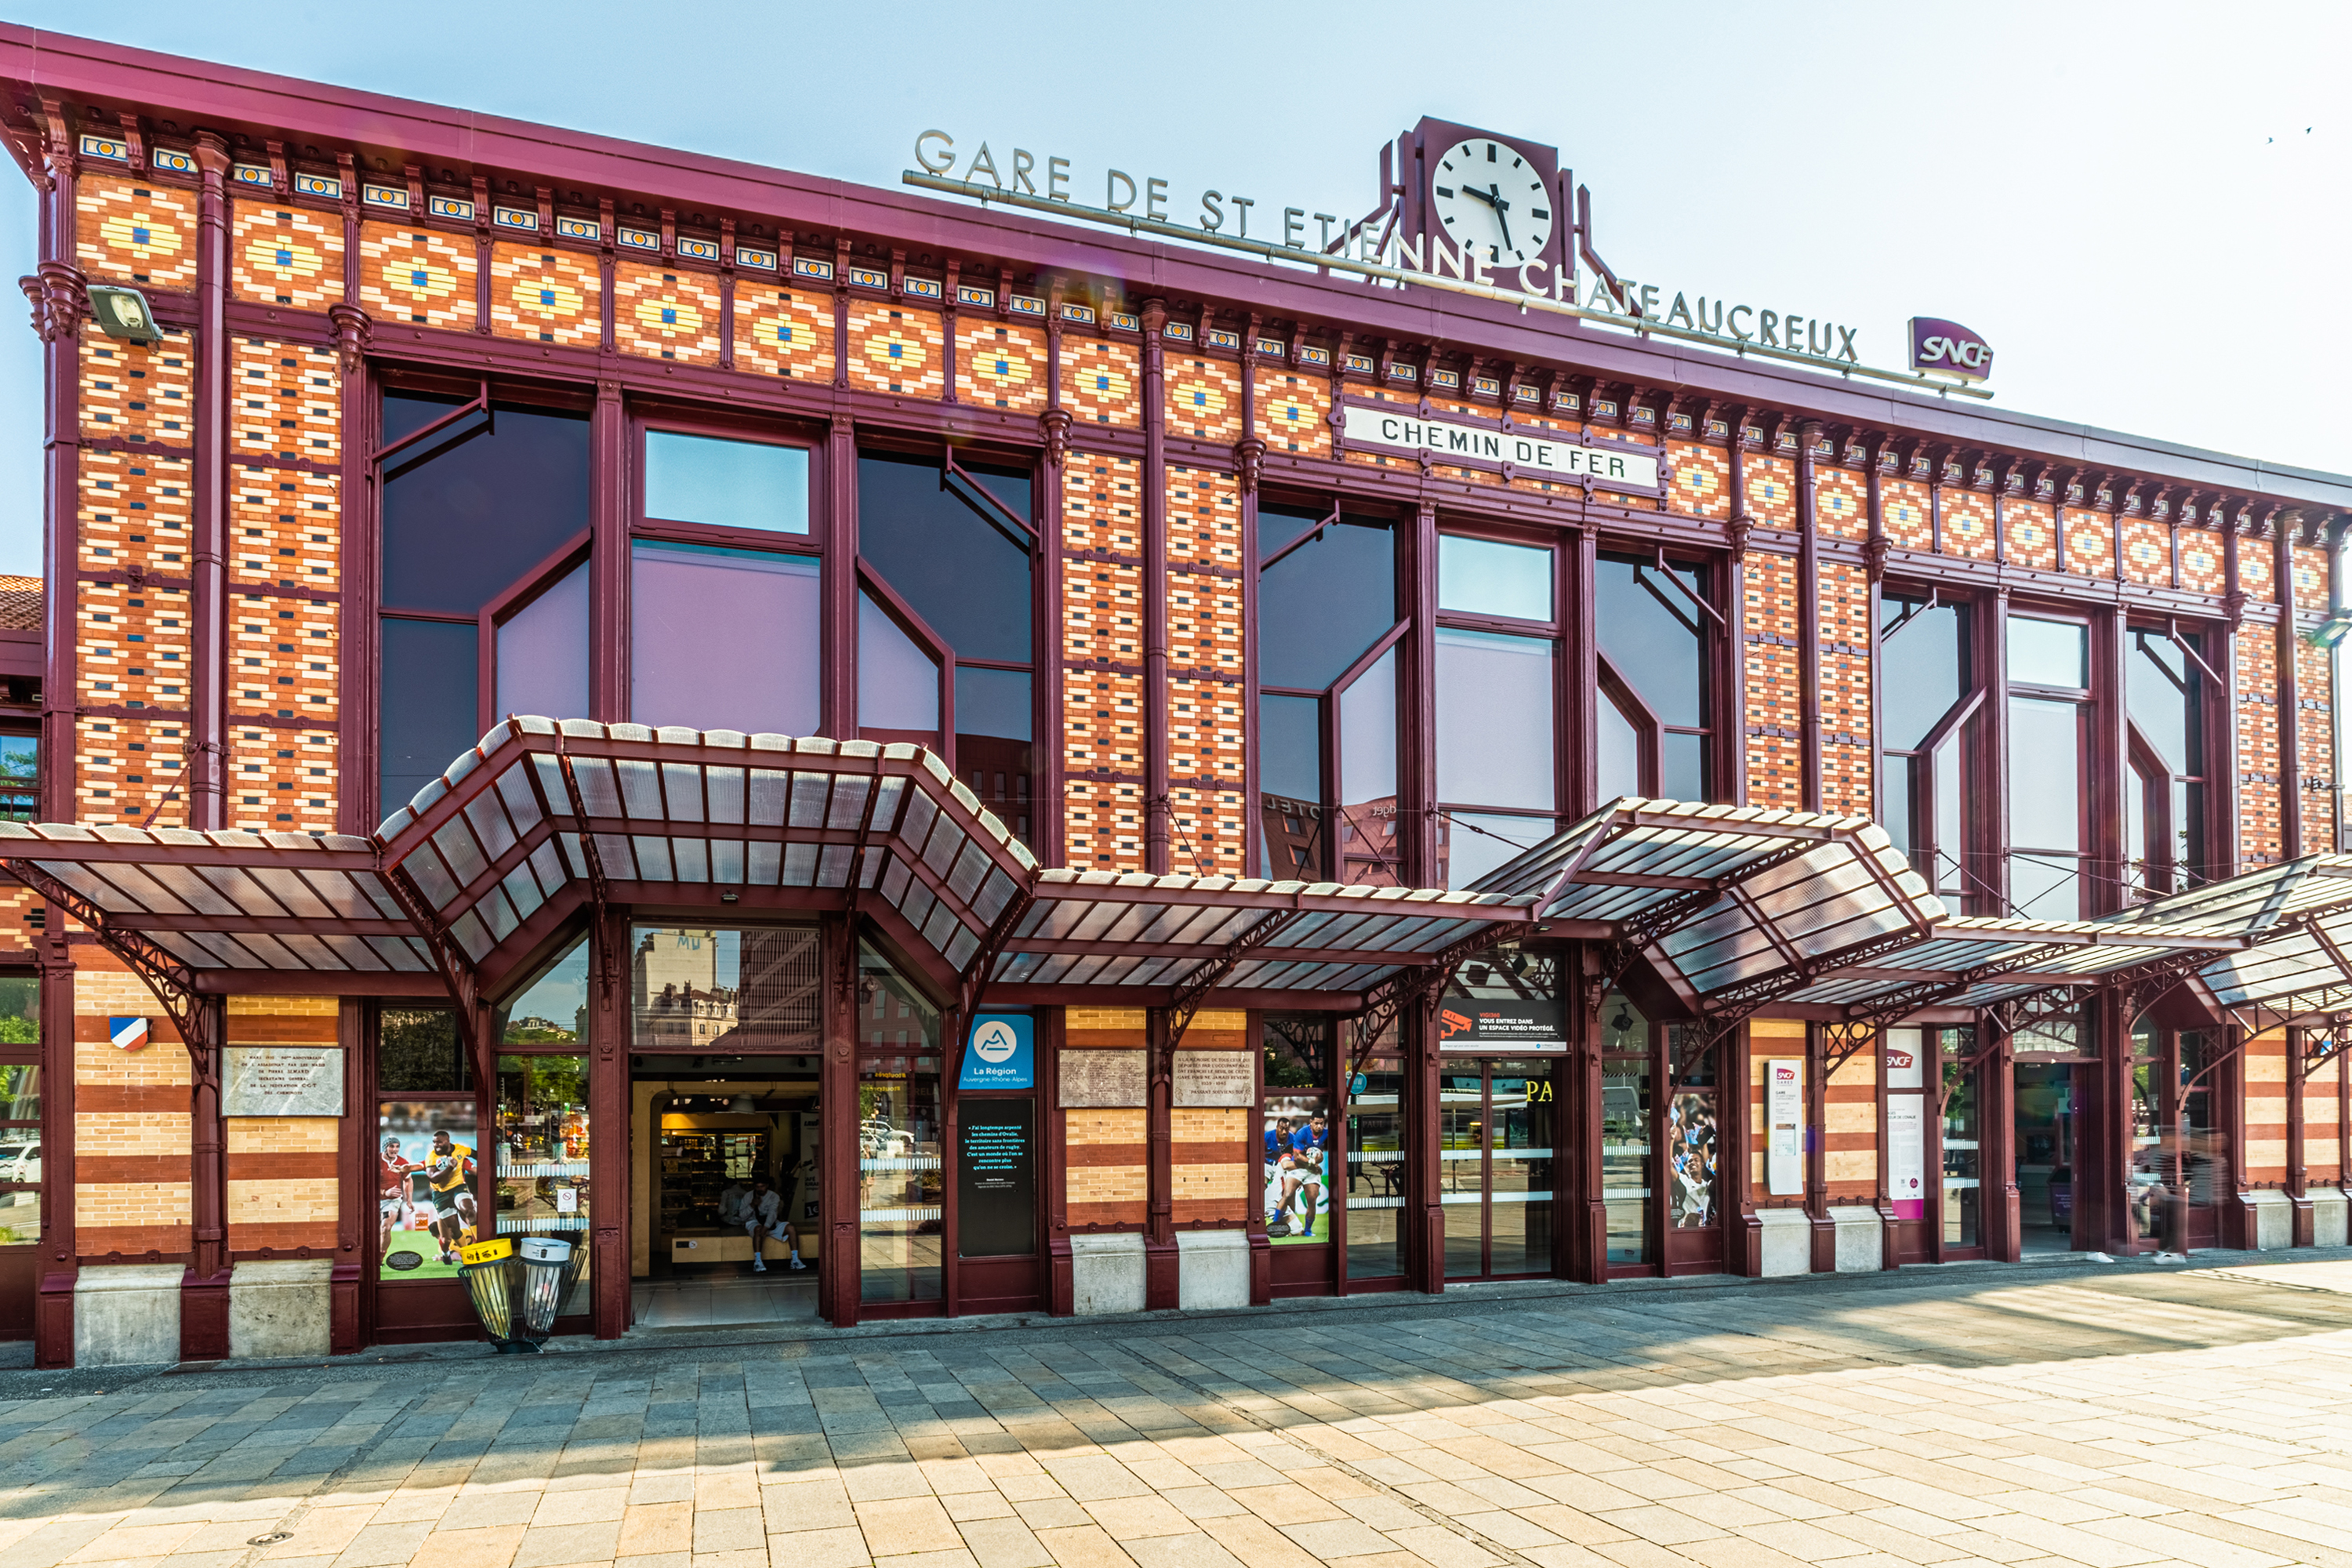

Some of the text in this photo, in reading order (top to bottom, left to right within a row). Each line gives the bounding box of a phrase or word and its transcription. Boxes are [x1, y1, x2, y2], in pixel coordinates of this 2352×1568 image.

[914, 129, 1859, 361] GARE DE ST ETIENNE CHATEAUCREUX
[1920, 336, 1994, 369] SNCF
[1382, 418, 1626, 478] CHEMIN DE FER
[986, 1067, 1016, 1076] Région
[1886, 1056, 1911, 1066] SNCF
[1526, 1080, 1553, 1102] PA
